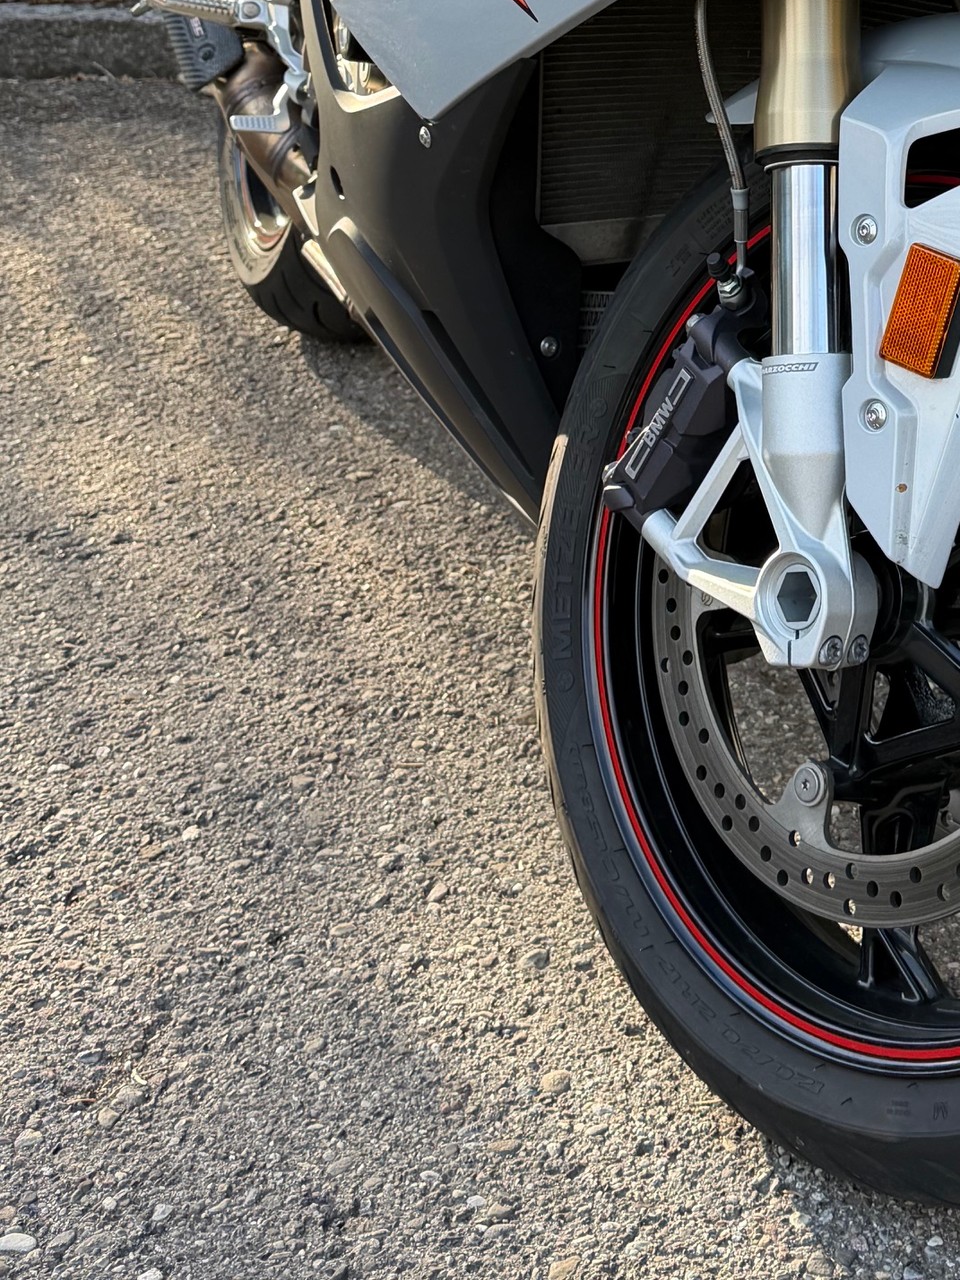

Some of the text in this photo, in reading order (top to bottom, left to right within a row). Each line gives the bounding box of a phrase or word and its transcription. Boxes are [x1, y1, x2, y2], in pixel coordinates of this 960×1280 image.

[762, 363, 817, 374] ARZOCCHI
[643, 396, 675, 448] BMW
[551, 423, 601, 660] METZELER
